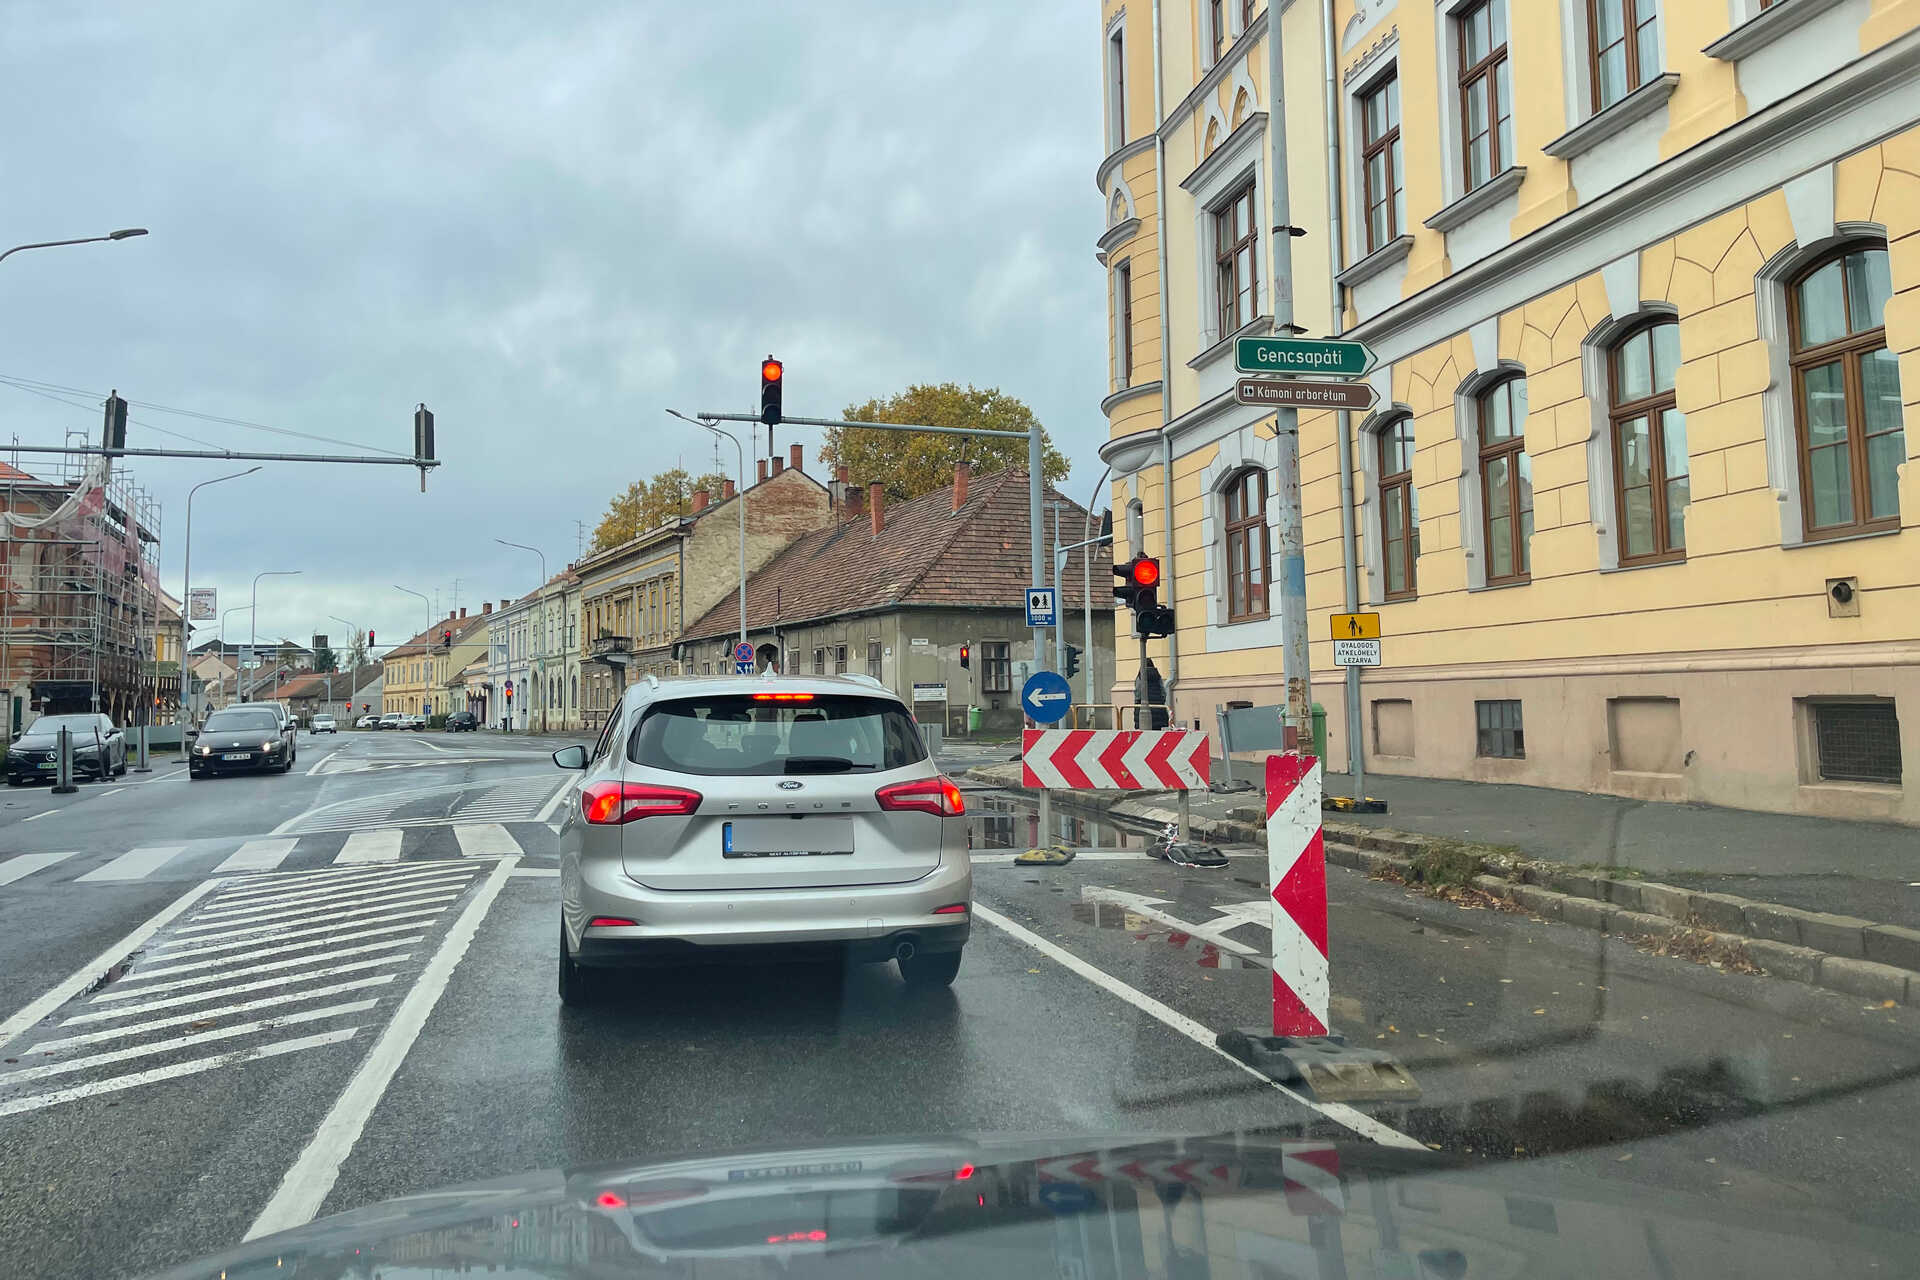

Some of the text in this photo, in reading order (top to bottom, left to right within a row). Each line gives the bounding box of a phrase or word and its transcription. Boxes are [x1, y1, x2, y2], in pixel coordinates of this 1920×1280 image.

[1257, 346, 1342, 367] Gencsapáti
[1257, 386, 1346, 402] Kámoni arborétum
